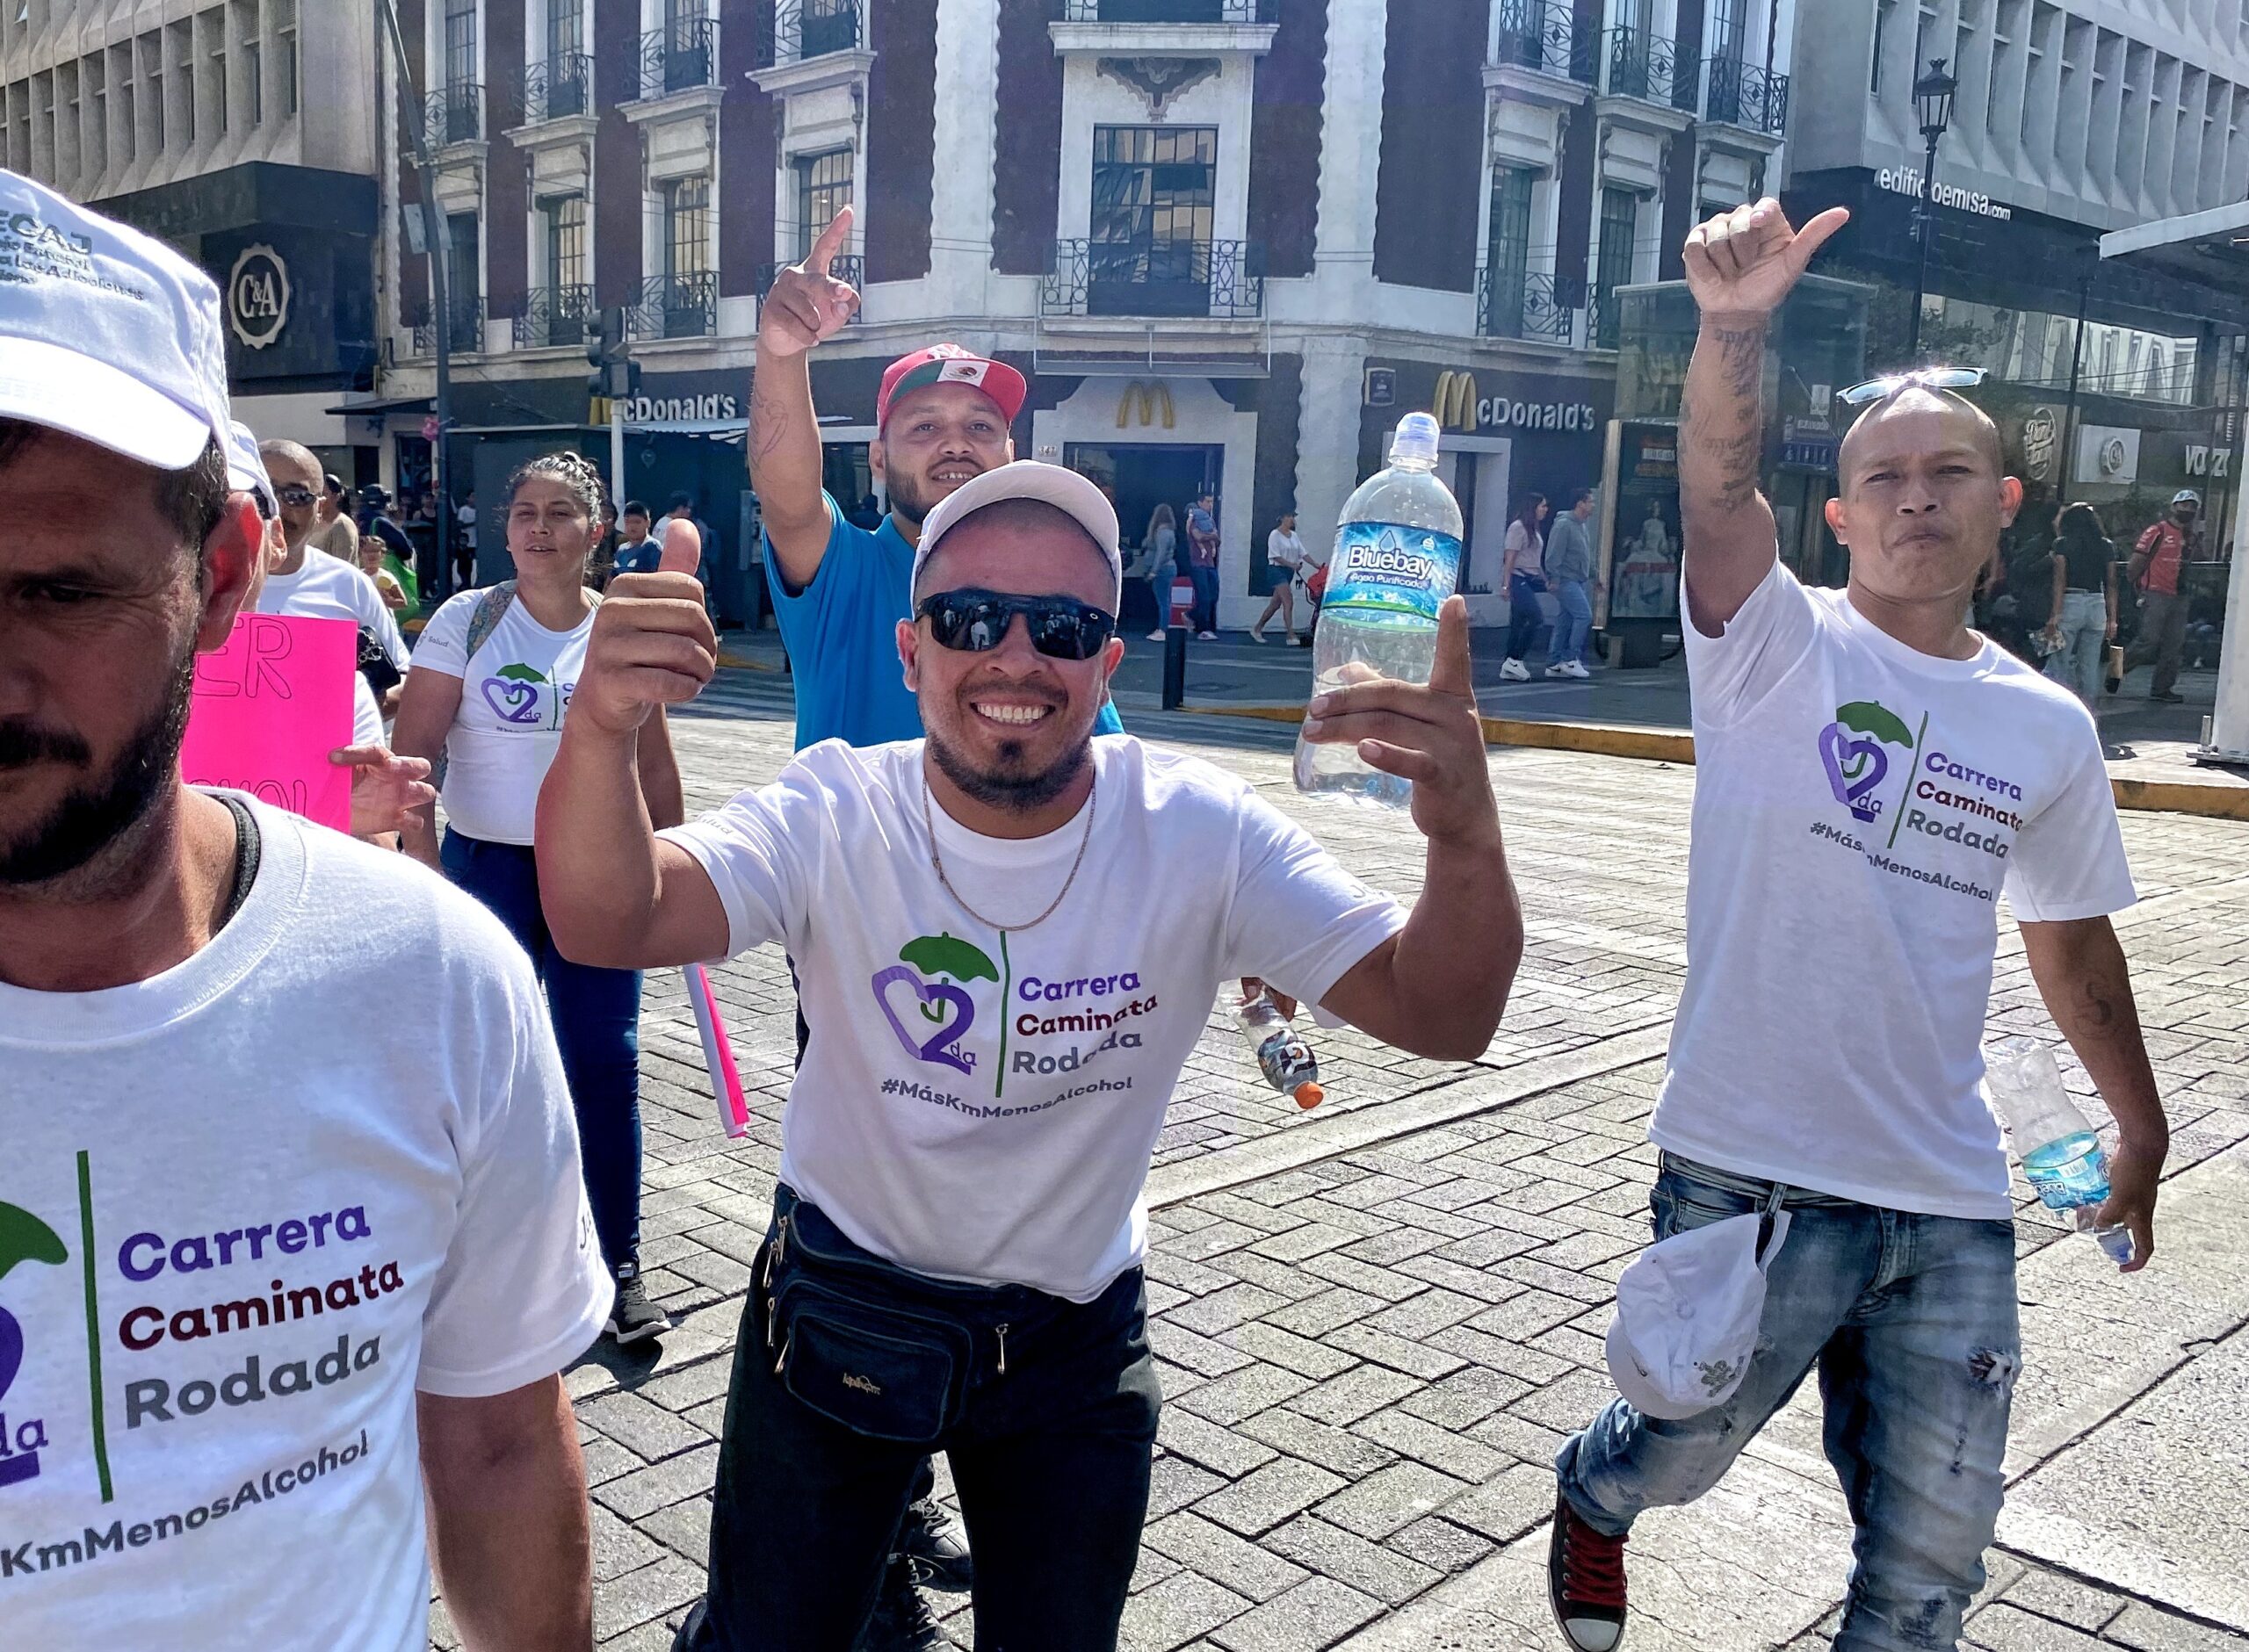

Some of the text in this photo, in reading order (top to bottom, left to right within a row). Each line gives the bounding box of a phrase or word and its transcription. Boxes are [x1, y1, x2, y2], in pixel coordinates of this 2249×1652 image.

[1880, 165, 2011, 221] edificoemisa.com
[238, 271, 279, 319] C&A
[1348, 544, 1434, 581] Bluebay
[1925, 752, 2022, 802] Carrera
[1906, 808, 2010, 860] Rodada
[1018, 970, 1141, 1003] Carrera
[1016, 993, 1158, 1036] Caminata
[1011, 1030, 1143, 1076] Rodada
[880, 1076, 1133, 1120] #MásKmMenosAlcohol
[118, 1205, 372, 1283] Carrera
[118, 1259, 405, 1352] Caminata
[123, 1332, 382, 1430] Rodada
